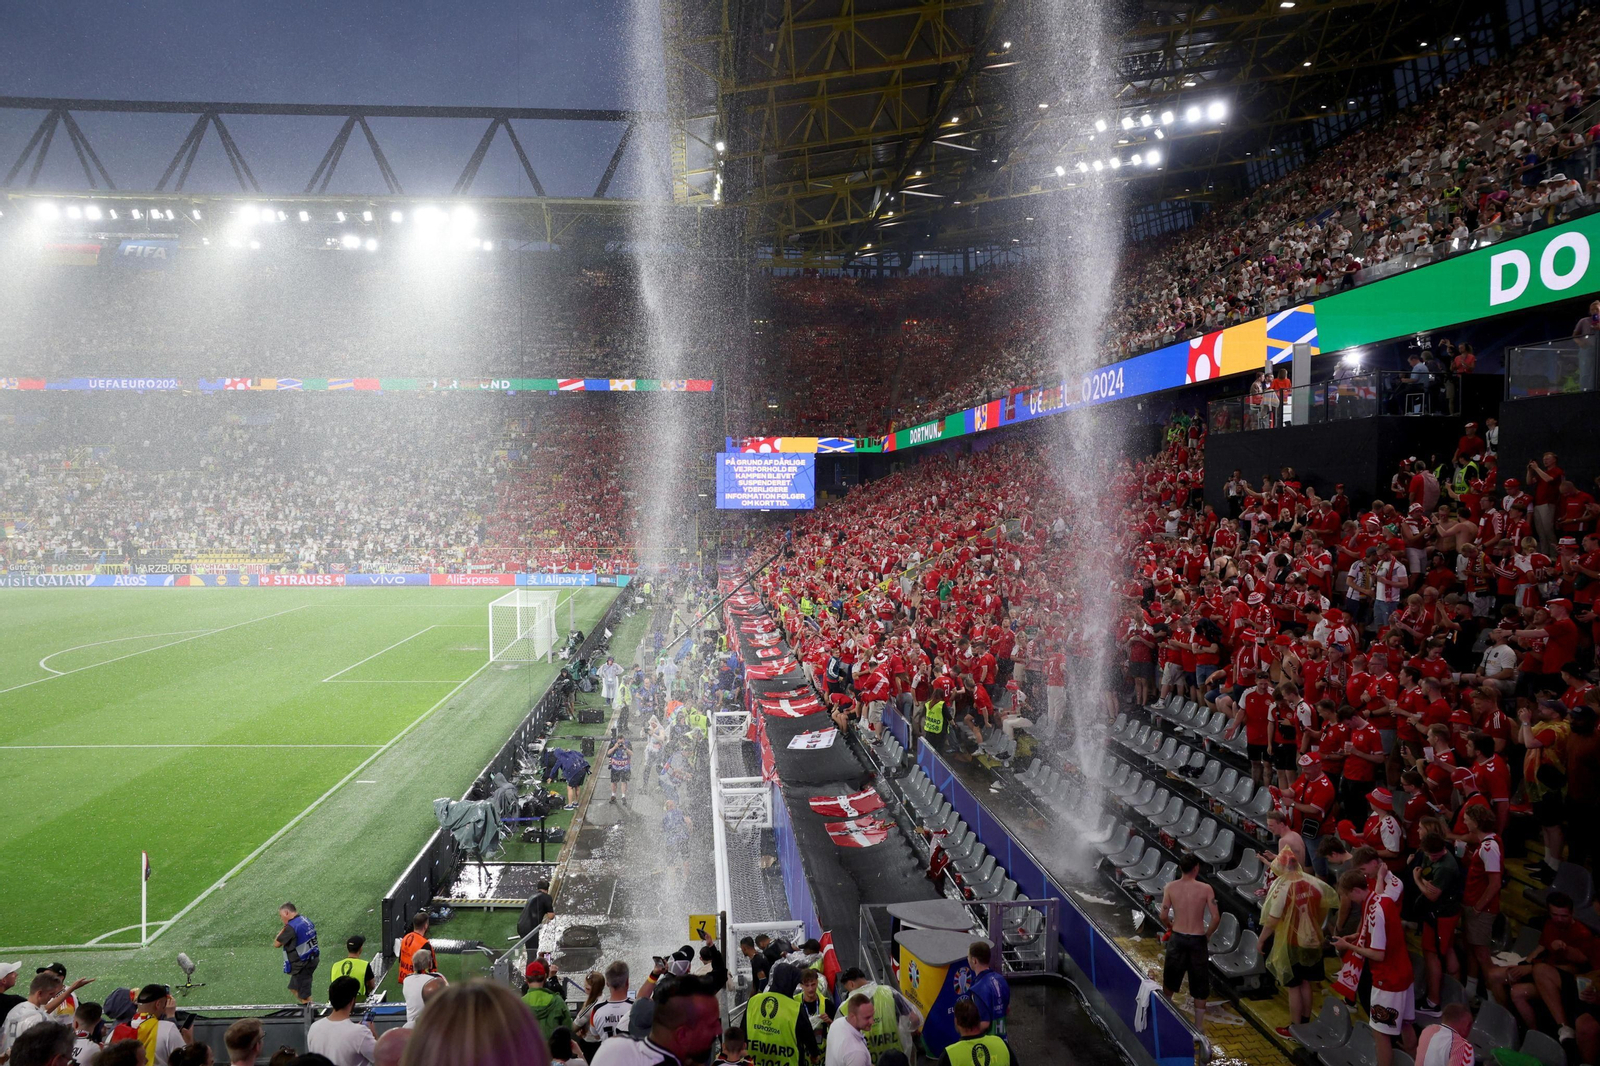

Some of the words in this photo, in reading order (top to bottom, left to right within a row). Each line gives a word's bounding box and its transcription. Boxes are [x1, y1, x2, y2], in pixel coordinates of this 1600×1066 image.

[123, 245, 167, 260] FIFA
[89, 379, 120, 388] UEFA
[121, 379, 155, 388] EURO
[156, 379, 178, 388] 202
[1092, 367, 1125, 400] 2024
[725, 457, 736, 466] PÅ
[774, 457, 806, 466] DÅRLIGE
[135, 564, 188, 574] HARZBURG
[0, 574, 34, 587] visit
[35, 574, 86, 587] QATAR
[274, 575, 332, 585] STRAUSS
[369, 574, 406, 584] vivo
[446, 574, 500, 586] AliExpress
[699, 920, 706, 931] 7
[604, 1013, 624, 1024] MÜLL
[745, 1040, 796, 1058] TEWARD
